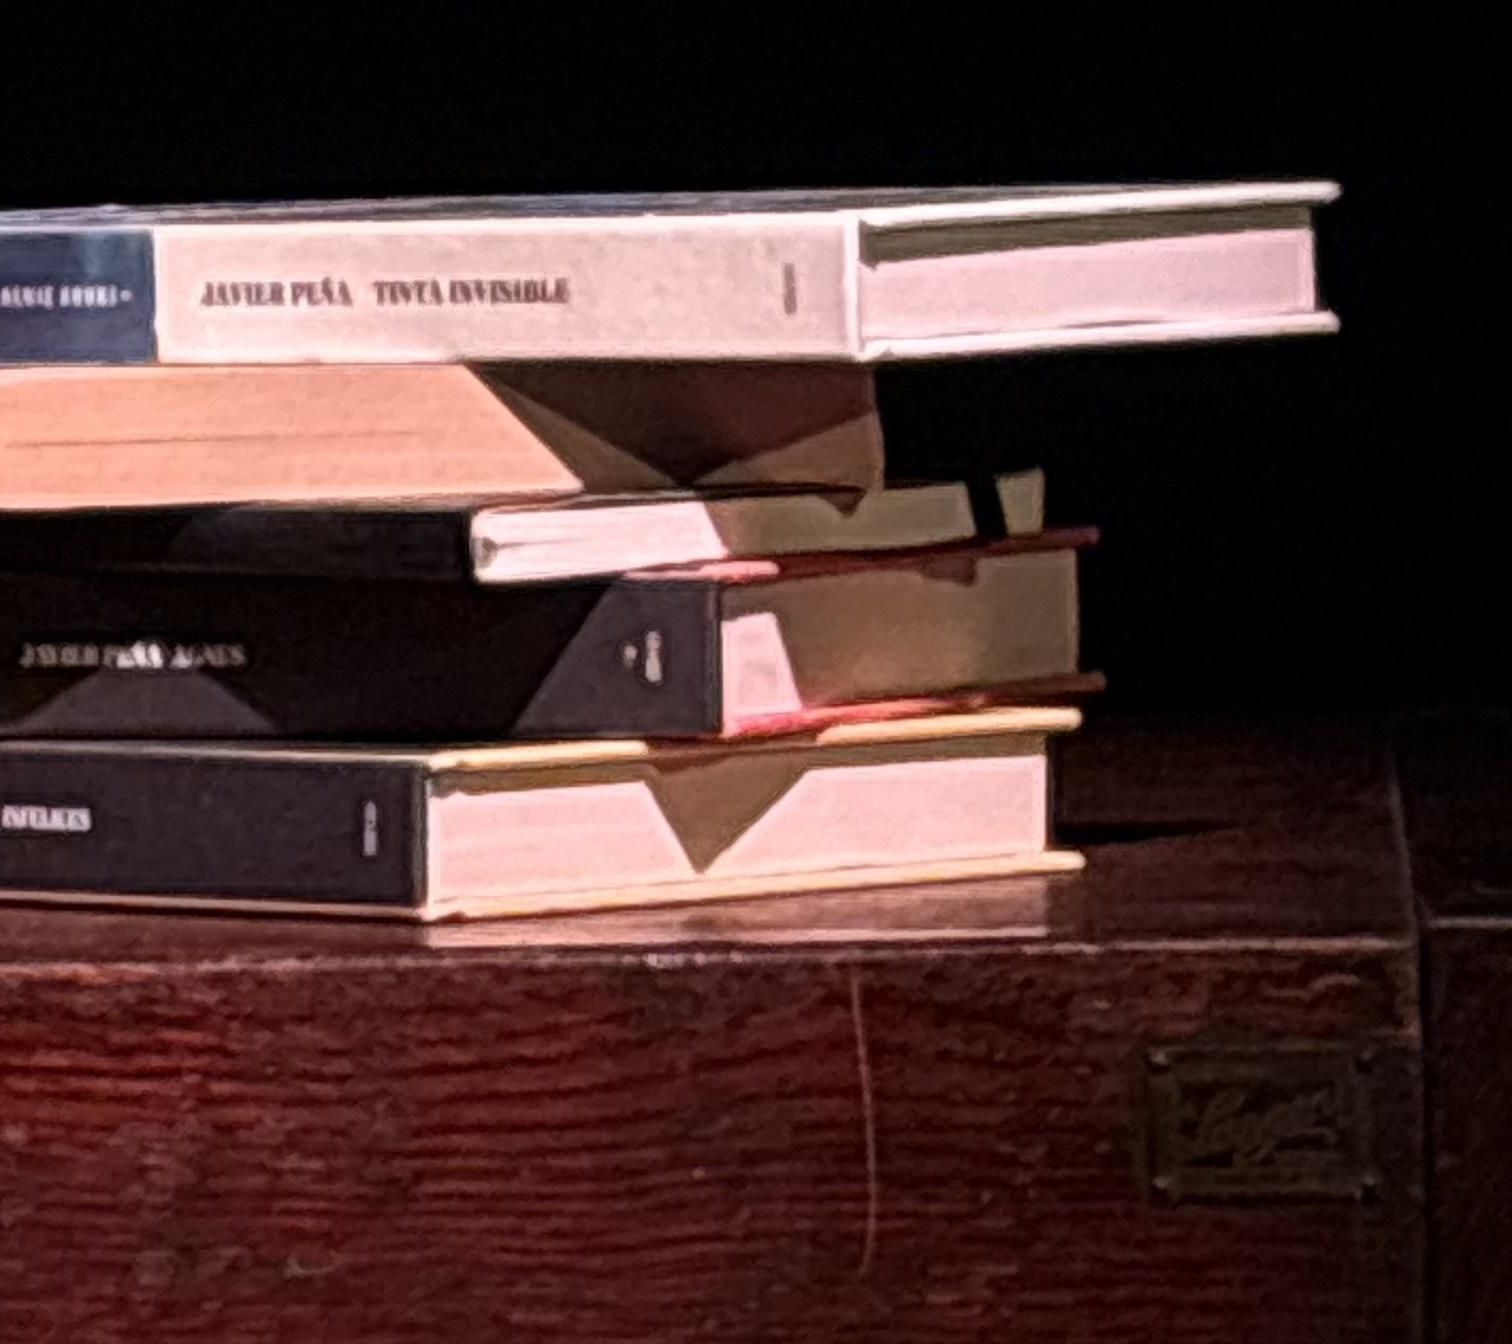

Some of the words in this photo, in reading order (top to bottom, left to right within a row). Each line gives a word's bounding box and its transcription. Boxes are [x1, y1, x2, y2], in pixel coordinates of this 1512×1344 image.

[200, 280, 285, 306] JAVIER
[290, 276, 354, 307] PEÑA
[373, 278, 443, 306] TINTA
[448, 277, 570, 306] INVISIBLE
